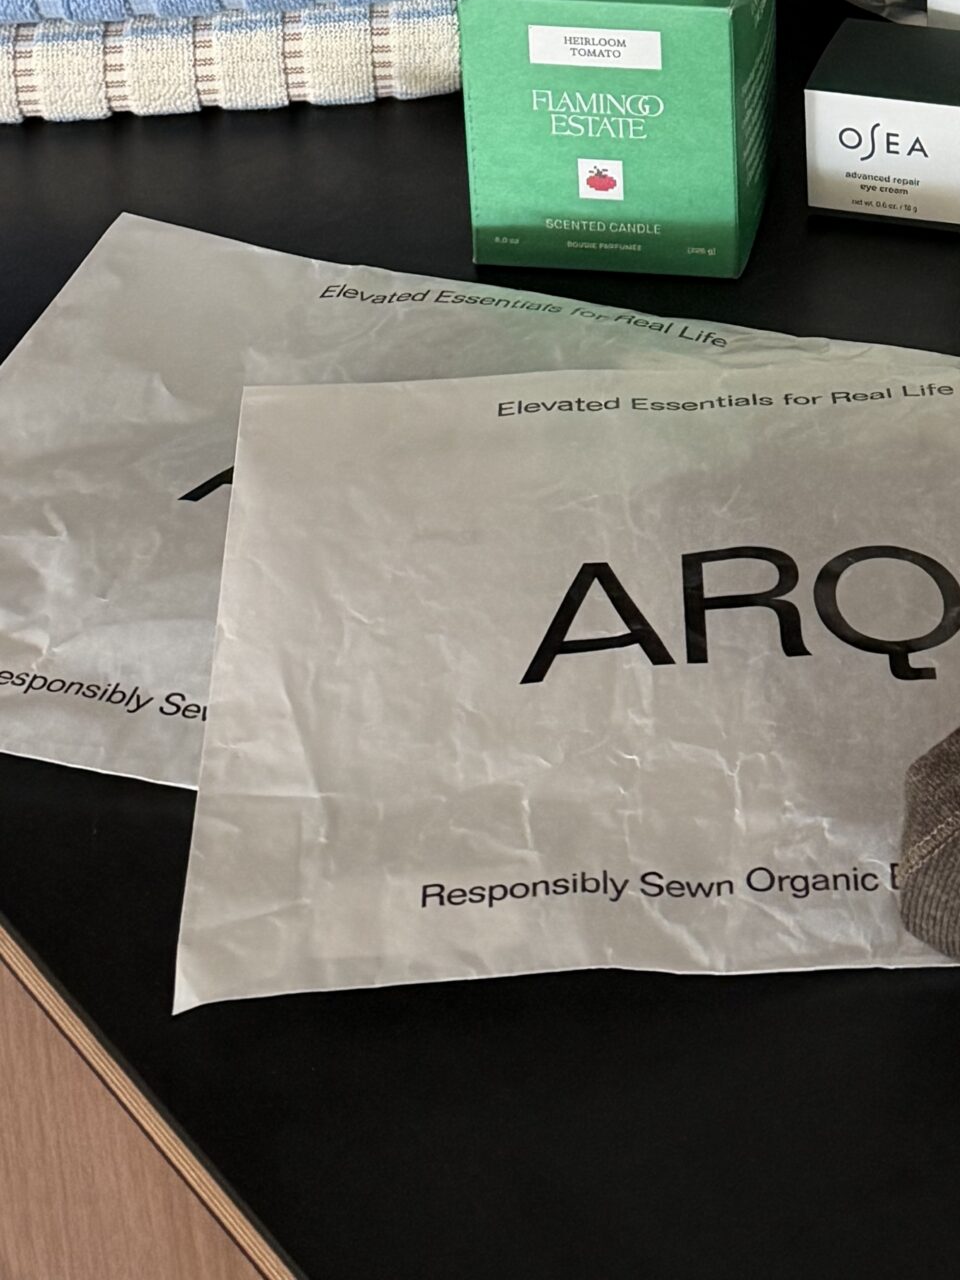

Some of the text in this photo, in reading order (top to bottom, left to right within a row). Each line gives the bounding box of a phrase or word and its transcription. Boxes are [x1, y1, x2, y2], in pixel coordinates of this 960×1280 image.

[563, 35, 628, 49] HEIRLOOM
[569, 48, 622, 60] TOMATO
[532, 89, 665, 118] FLAMINGO
[550, 114, 648, 140] ESTATE
[839, 123, 929, 162] OSEA
[845, 171, 920, 187] advanced repair
[860, 183, 909, 196] eye cream
[545, 218, 661, 235] SCENTED CANDLE
[319, 283, 729, 349] Elevated Essentials for Real Life
[497, 382, 955, 419] Elevated Essentials for Real Life
[0, 669, 153, 713] esponsibly
[421, 869, 629, 909] Responsibly
[639, 871, 734, 899] Sewn
[745, 865, 879, 897] Organic
